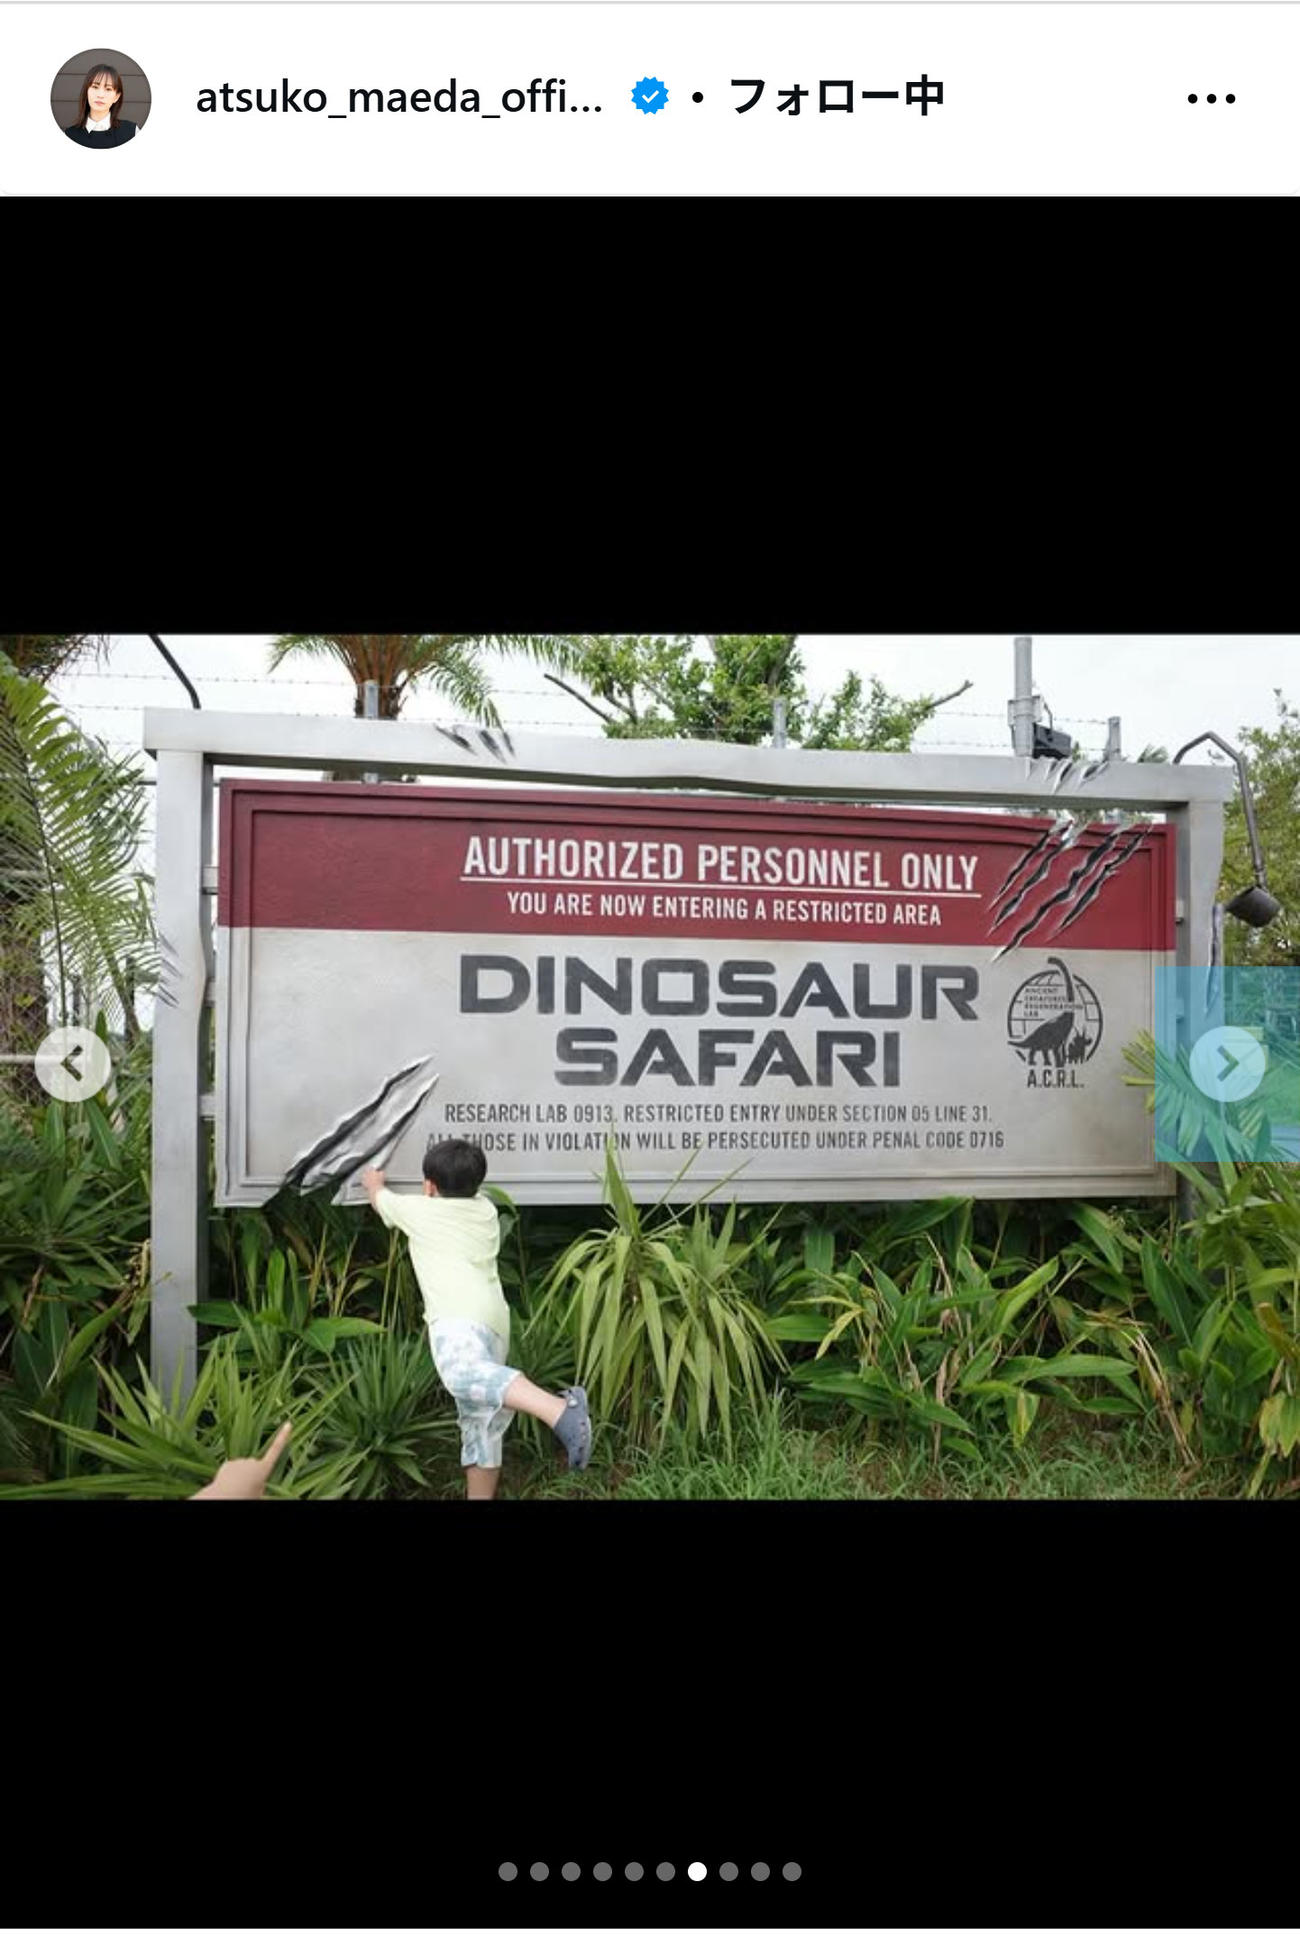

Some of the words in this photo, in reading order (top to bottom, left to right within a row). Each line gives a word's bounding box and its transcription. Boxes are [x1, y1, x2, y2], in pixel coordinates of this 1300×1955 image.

[463, 836, 684, 880] AUTHORIZED
[697, 845, 890, 887] PERSONNEL
[901, 853, 979, 891] ONLY
[507, 892, 547, 914] YOU
[554, 893, 593, 915] ARE
[600, 894, 645, 917] NOW
[652, 895, 748, 919] ENTERING
[754, 900, 767, 921] A
[773, 900, 887, 924] RESTRICTED
[893, 903, 941, 926] AREA
[459, 954, 980, 1021] DINOSAUR
[554, 1027, 901, 1088] SAFARI
[1027, 1069, 1085, 1088] A.C.R.L.
[445, 1103, 530, 1123] RESEARCH
[535, 1103, 568, 1123] LAB
[624, 1103, 724, 1123] RESTRICTED
[730, 1104, 780, 1123] ENTRY
[785, 1104, 837, 1123] UNDER
[842, 1105, 907, 1123] SECTION
[911, 1106, 930, 1123] 05
[935, 1105, 967, 1123] LINE
[972, 1106, 993, 1123] 31.
[522, 1133, 540, 1151] IN
[636, 1132, 676, 1151] WILL
[681, 1132, 702, 1150] BE
[708, 1131, 811, 1150] PERSECUTED
[815, 1131, 867, 1150] UNDER
[872, 1131, 921, 1149] PENAL
[925, 1131, 964, 1149] CODE
[969, 1131, 1005, 1149] 0716
